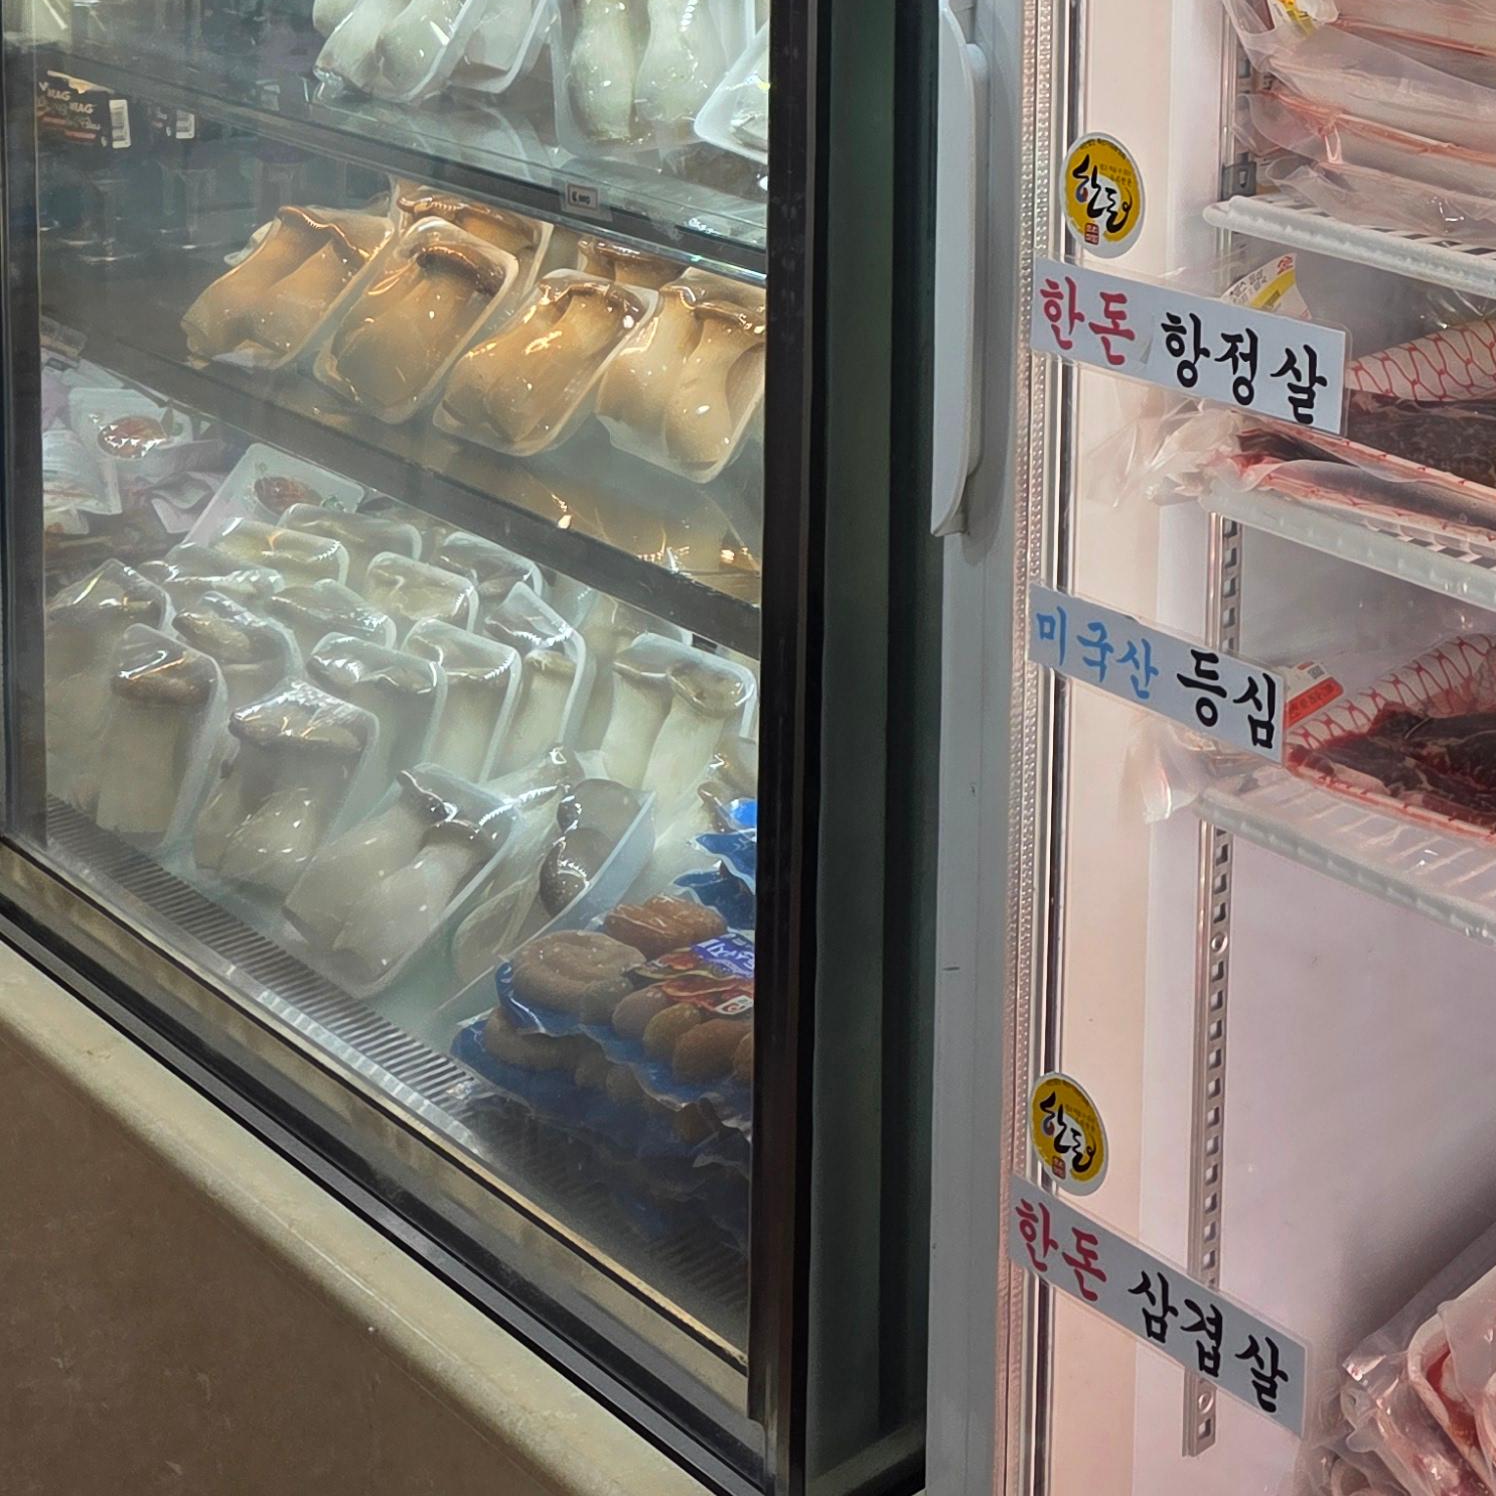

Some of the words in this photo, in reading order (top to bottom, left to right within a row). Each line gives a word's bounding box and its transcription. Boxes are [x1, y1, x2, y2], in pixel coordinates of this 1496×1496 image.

[1040, 276, 1135, 365] 한돈
[1161, 312, 1327, 425] 항정살
[1036, 606, 1159, 700] 미국산
[1177, 649, 1276, 749] 등심
[1015, 1198, 1107, 1302] 한돈
[1128, 1270, 1288, 1413] 삼겹살
